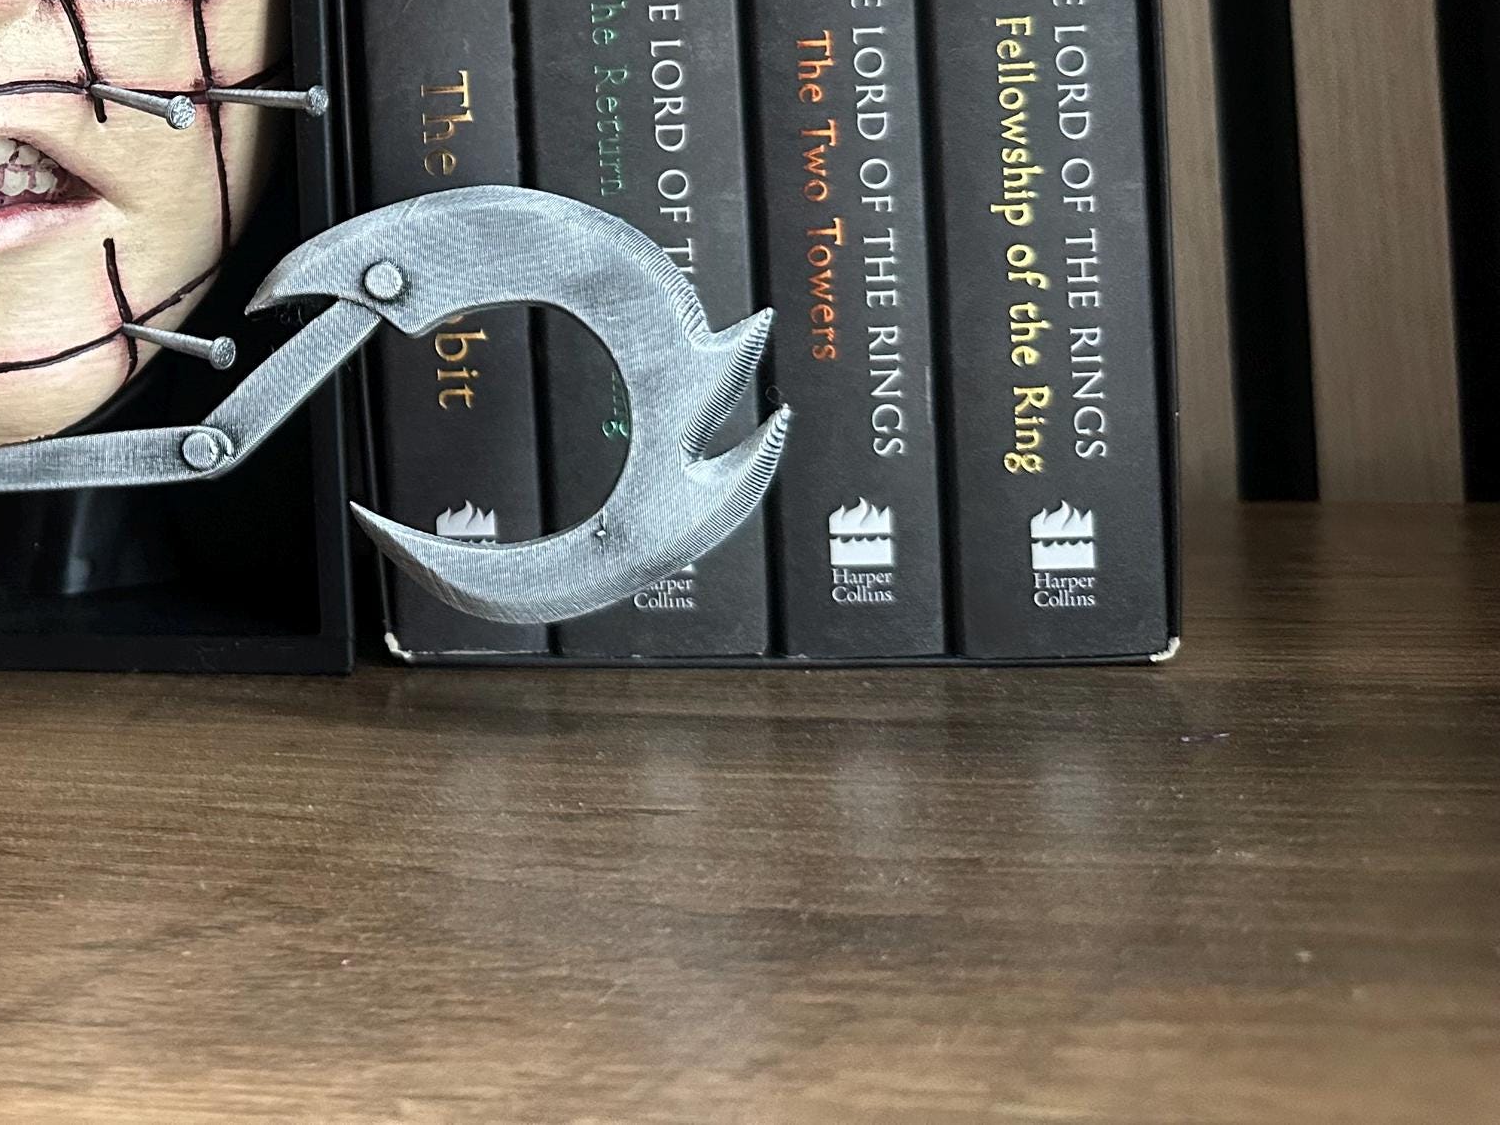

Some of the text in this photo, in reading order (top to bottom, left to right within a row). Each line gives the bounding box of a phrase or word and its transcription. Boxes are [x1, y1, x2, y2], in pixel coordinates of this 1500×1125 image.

[420, 69, 474, 176] The
[650, 39, 687, 152] LORD
[849, 25, 891, 142] LORD
[990, 14, 1045, 228] Fellowship
[1053, 25, 1093, 142] LORD
[594, 65, 628, 197] Return
[657, 169, 691, 224] OF
[795, 30, 844, 363] The Two Towers
[858, 157, 895, 214] OF
[1060, 157, 1097, 214] OF
[860, 227, 900, 310] THE
[1005, 244, 1053, 293] of
[1064, 227, 1103, 310] THE
[1007, 301, 1053, 368] the
[866, 325, 908, 458] RINGS
[1003, 384, 1054, 476] Ring
[1068, 325, 1109, 460] RINGS
[633, 591, 694, 608] Collins
[831, 585, 894, 604] Collins
[832, 568, 893, 590] Harper
[1033, 572, 1095, 594] Harper
[1033, 589, 1096, 608] Collins
